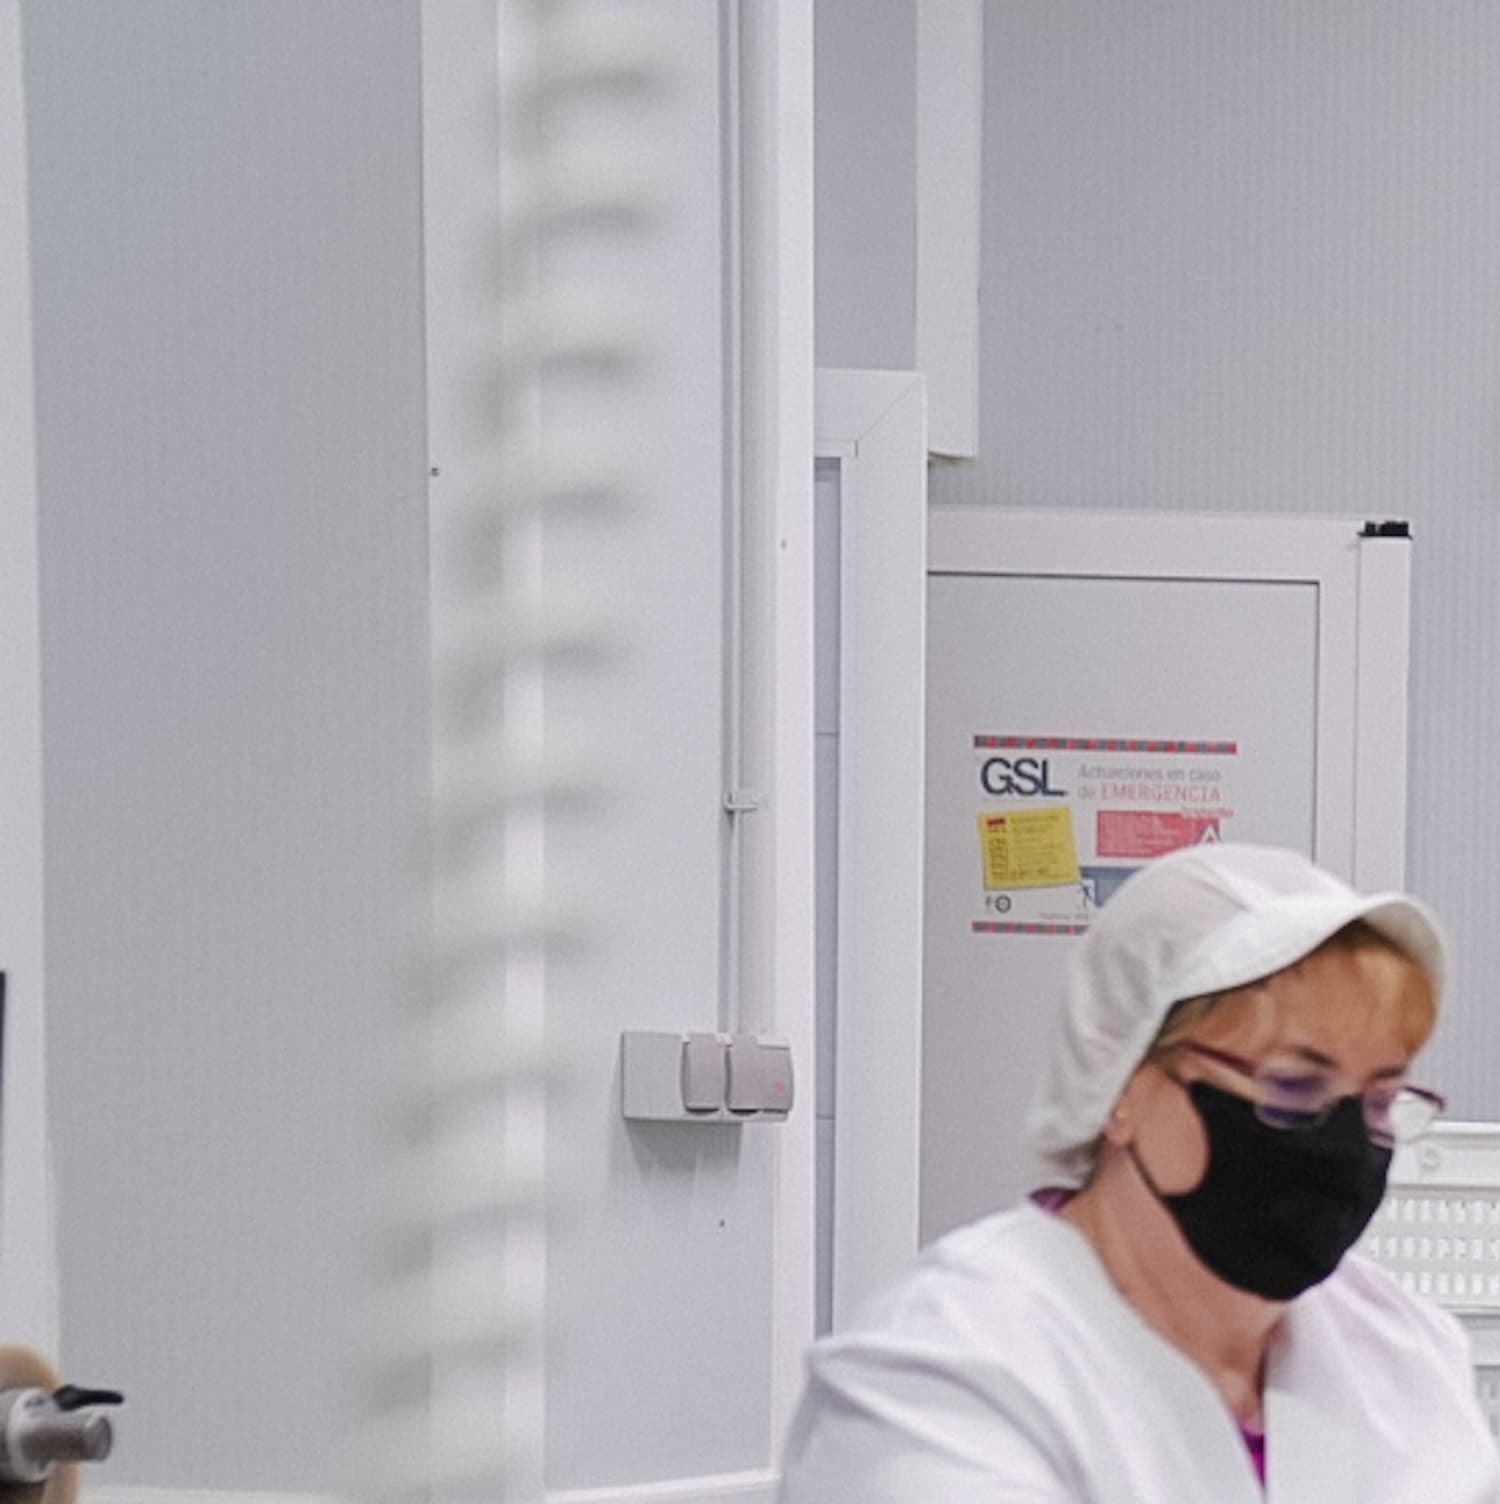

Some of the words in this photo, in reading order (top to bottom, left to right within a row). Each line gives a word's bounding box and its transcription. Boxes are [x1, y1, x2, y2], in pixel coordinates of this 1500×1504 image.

[980, 757, 1069, 797] GSL
[1167, 768, 1185, 781] en
[1188, 769, 1221, 782] caso
[1078, 784, 1096, 799] de
[1101, 783, 1221, 801] EMERGENCIA
